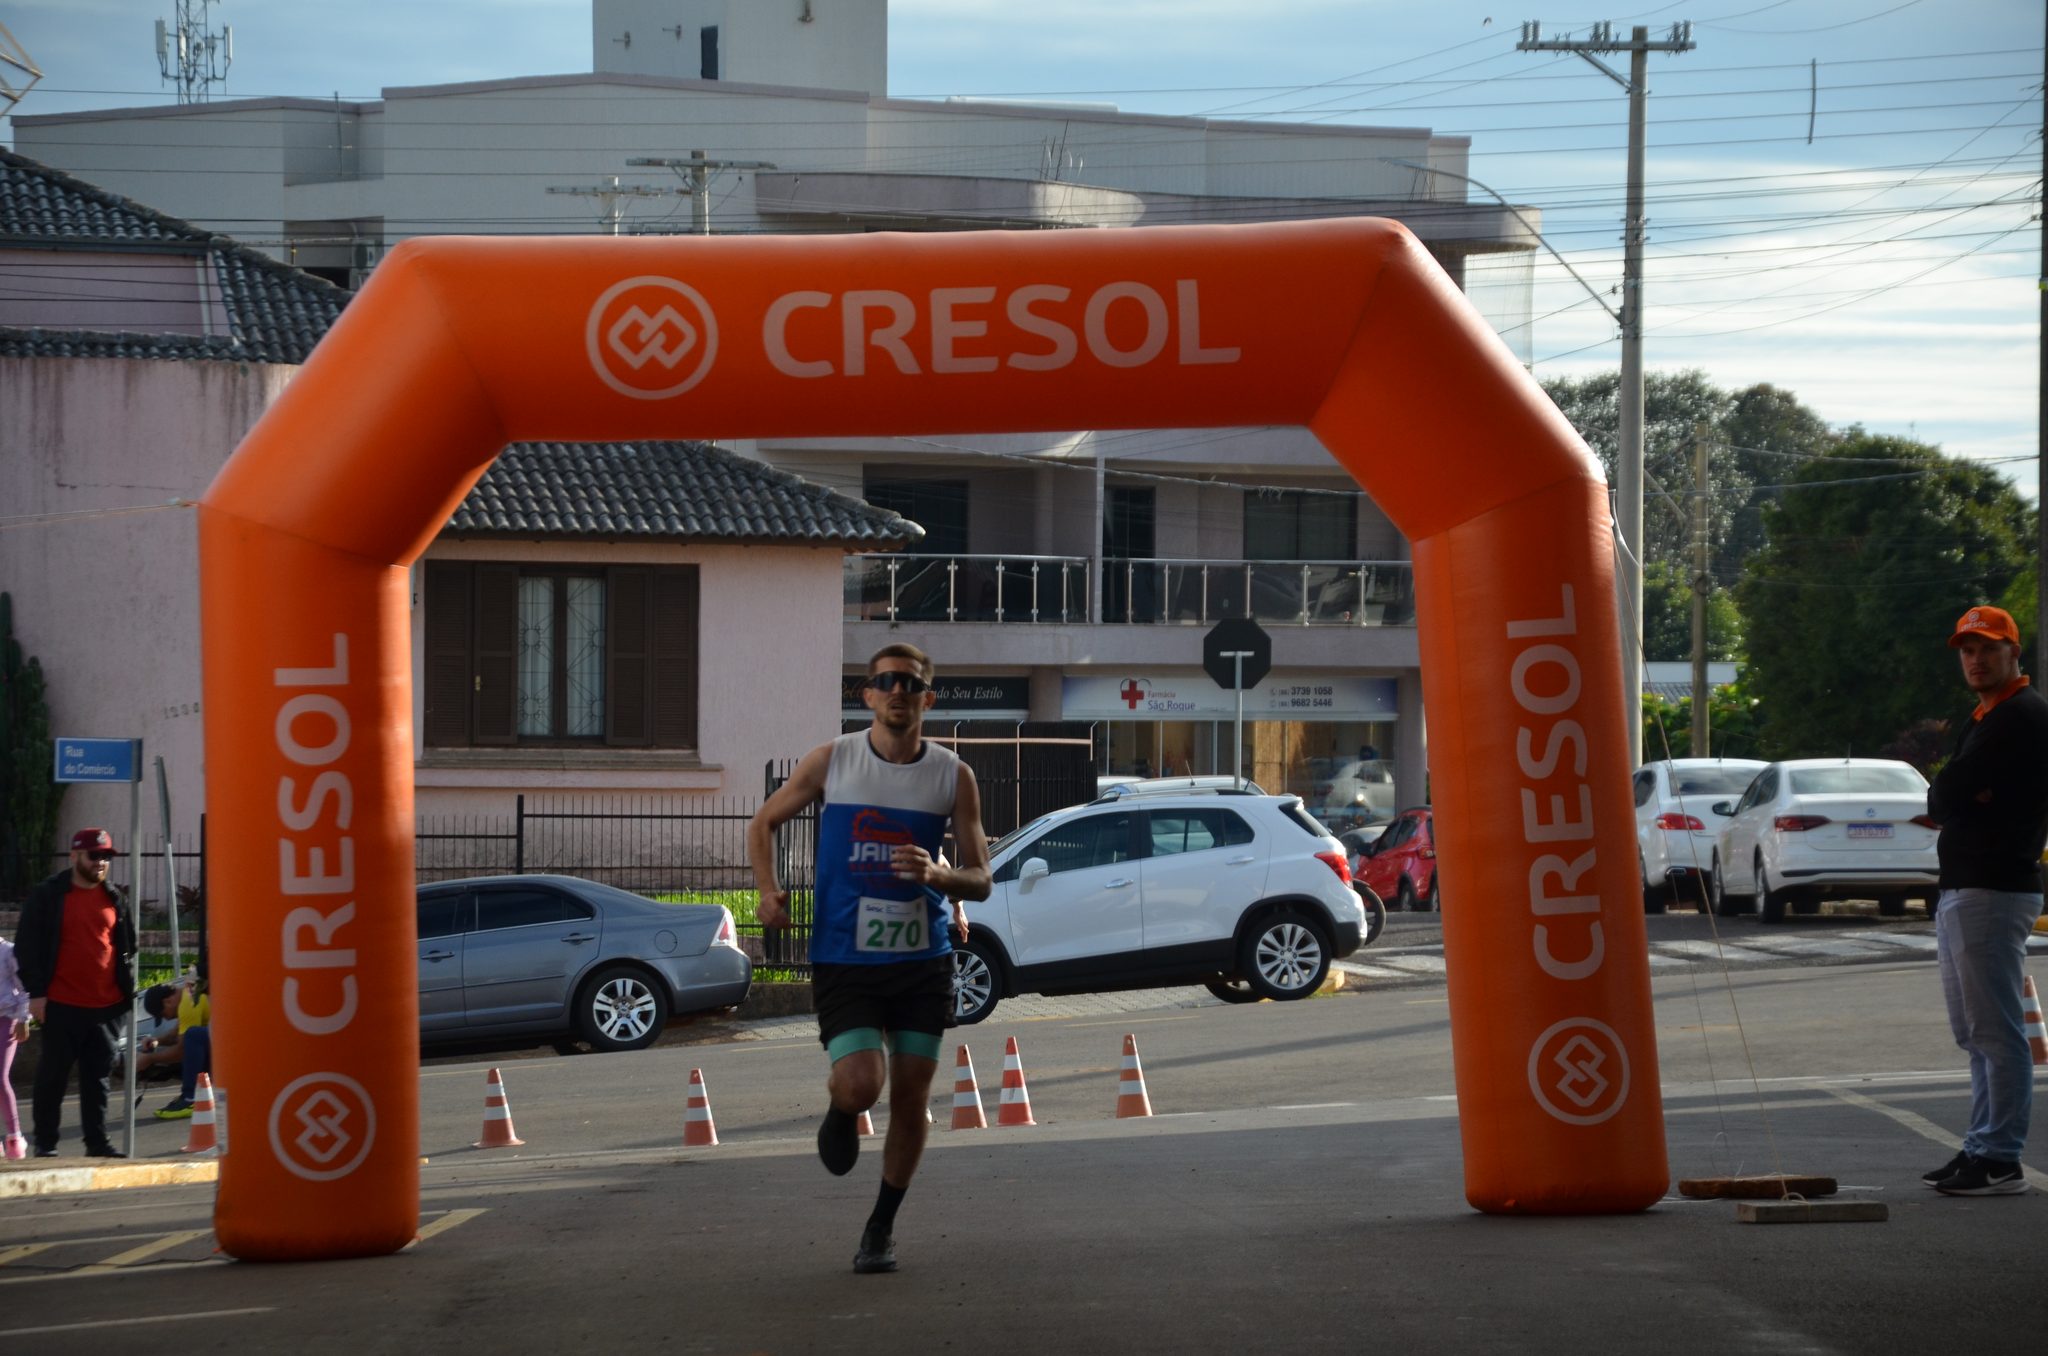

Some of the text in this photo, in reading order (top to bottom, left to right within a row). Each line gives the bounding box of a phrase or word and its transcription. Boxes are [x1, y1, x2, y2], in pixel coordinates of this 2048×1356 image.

[762, 278, 1242, 378] CRESOL
[952, 686, 971, 700] Seu
[974, 685, 1004, 700] Estilo
[1148, 700, 1196, 712] São Roque
[64, 745, 85, 757] Rua
[64, 762, 77, 775] do
[1506, 583, 1605, 981] CRESOL
[274, 632, 358, 1036] CRESOL
[865, 918, 921, 948] 270
